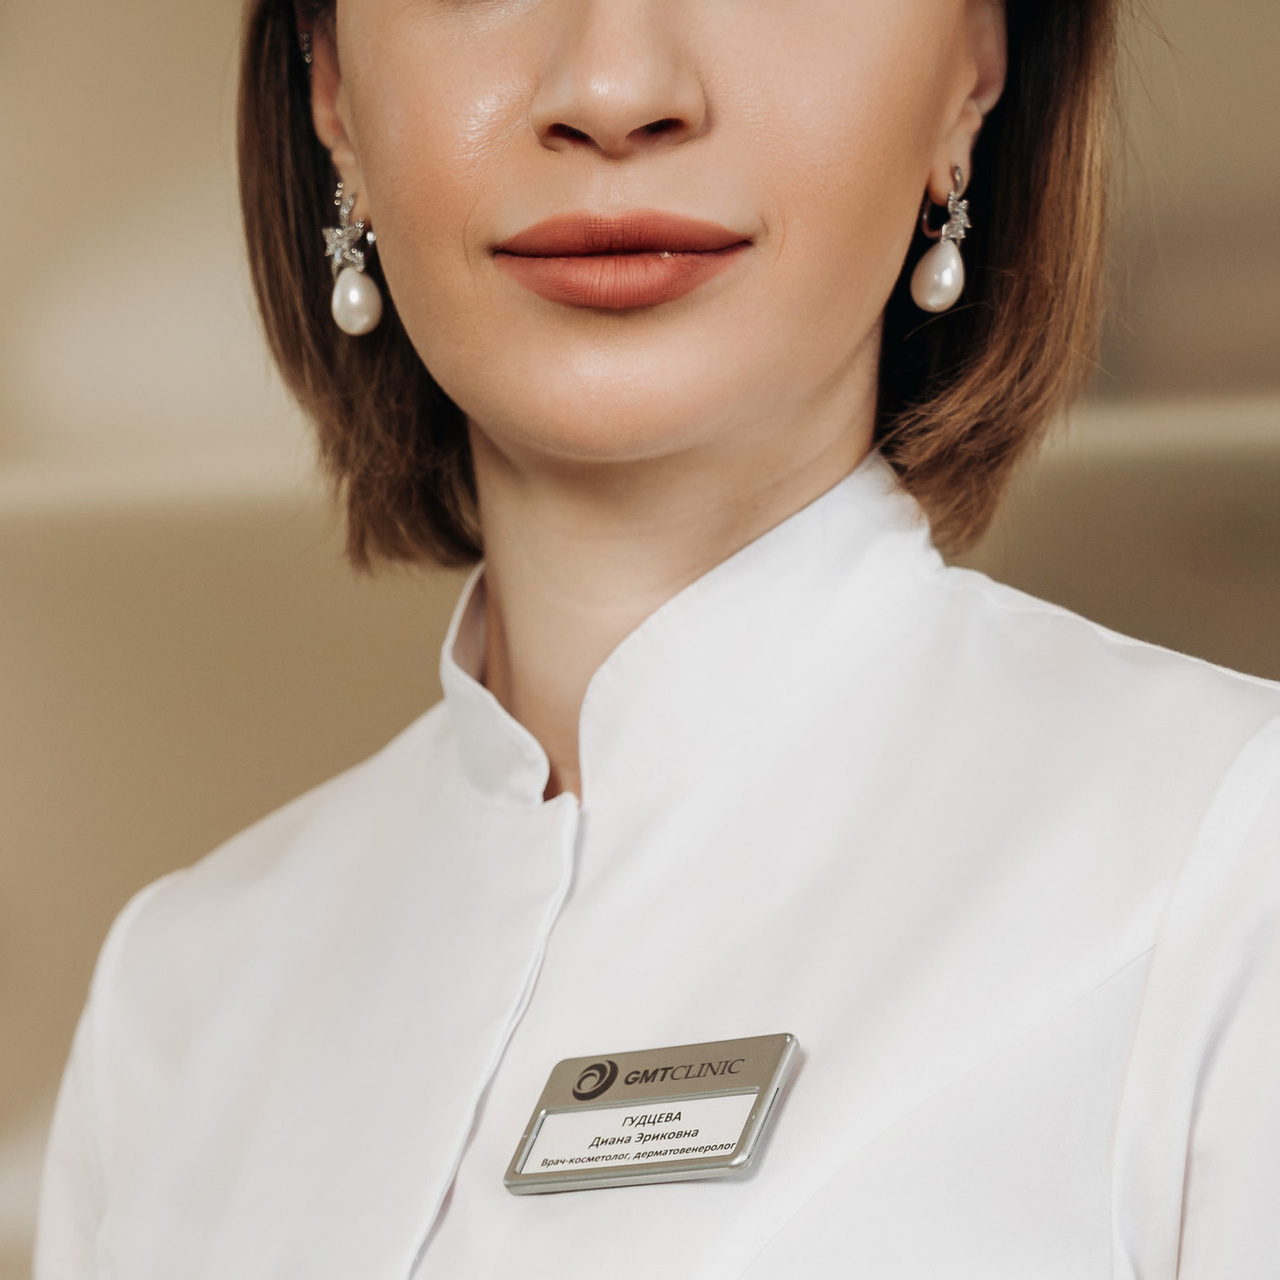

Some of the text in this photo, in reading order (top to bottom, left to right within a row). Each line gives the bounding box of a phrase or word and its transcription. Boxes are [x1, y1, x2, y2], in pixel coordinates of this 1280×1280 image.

[624, 1058, 746, 1086] GMTCLINIC
[622, 1111, 682, 1127] ГУДЦЕВА
[588, 1128, 699, 1150] Диана Эриковна
[541, 1151, 631, 1168] Врач-косметолог,
